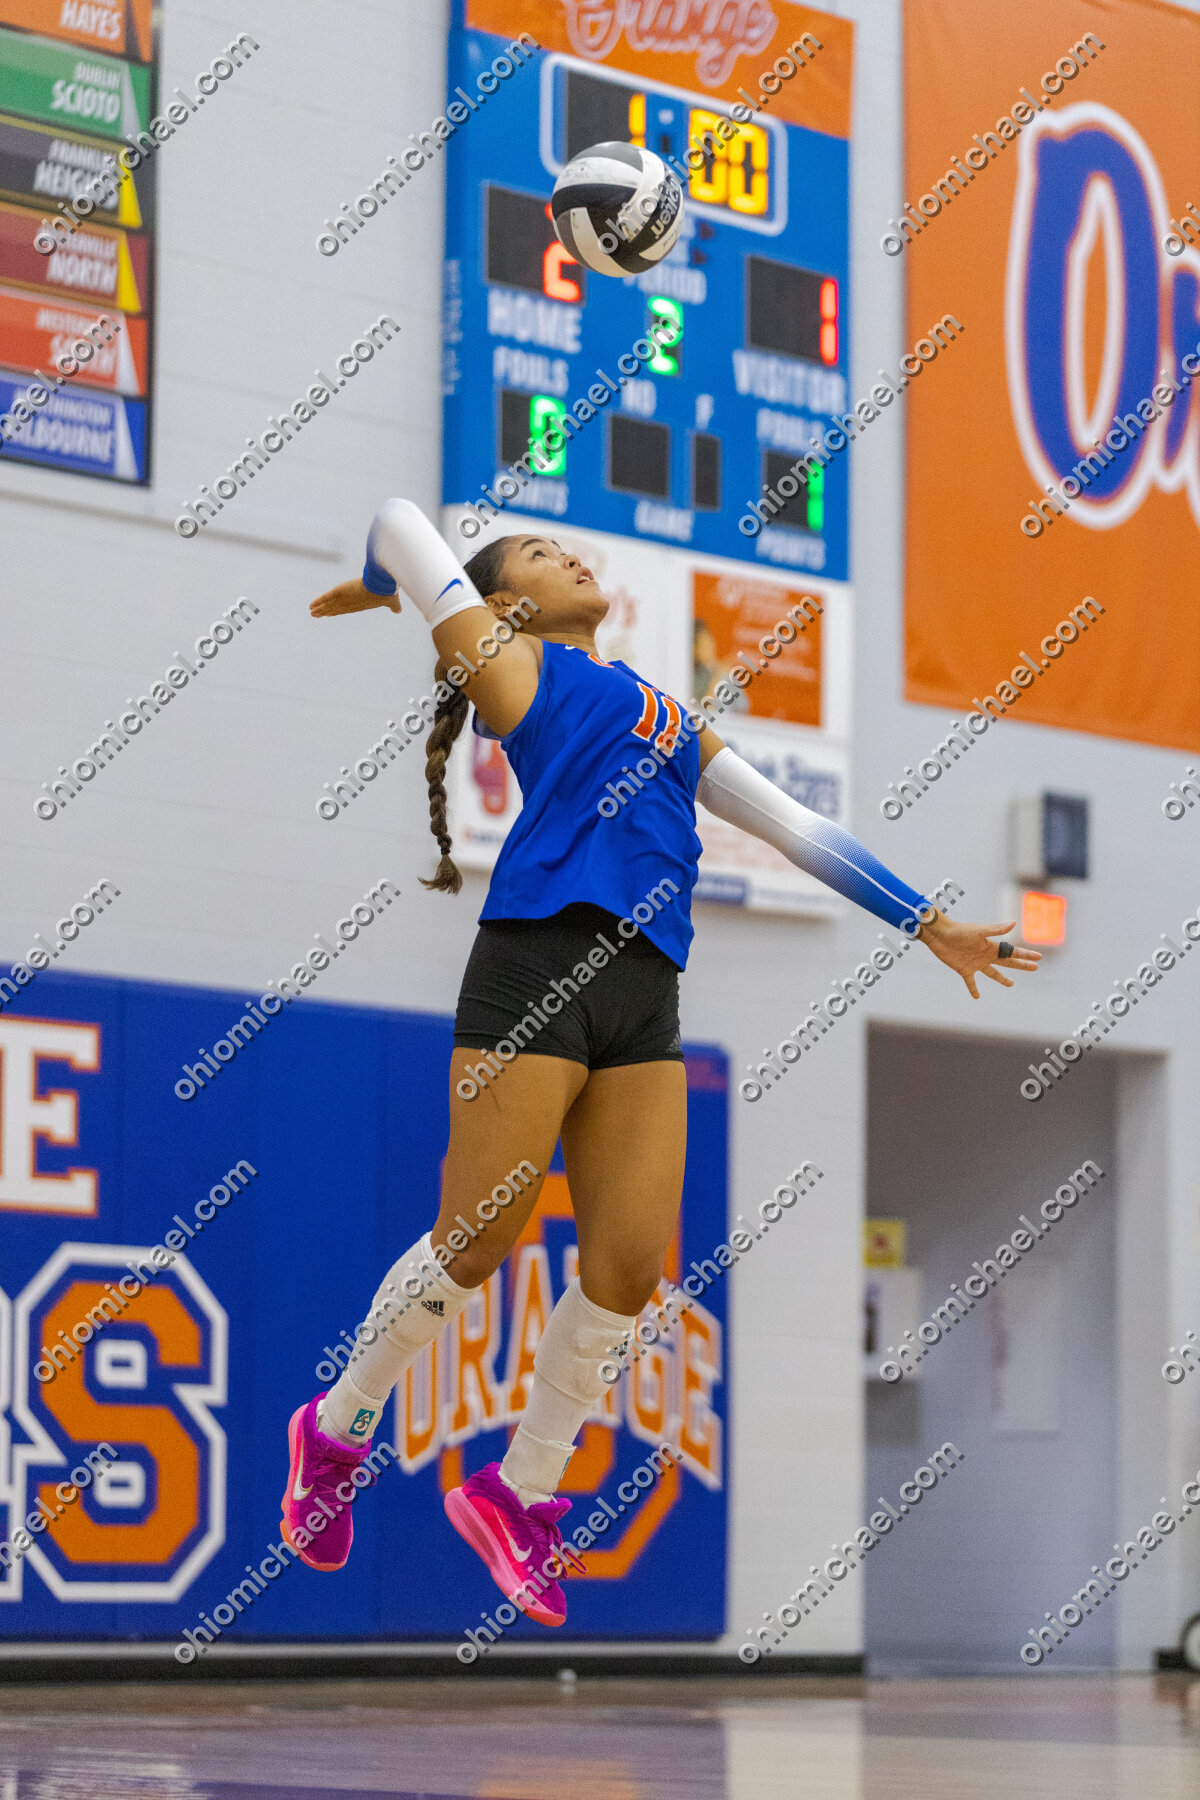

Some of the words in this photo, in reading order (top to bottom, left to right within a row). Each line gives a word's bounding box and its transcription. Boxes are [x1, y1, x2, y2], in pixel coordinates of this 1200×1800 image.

[59, 0, 122, 41] HAYES
[51, 79, 121, 123] SCIOTO
[46, 251, 118, 294] NORTH
[487, 284, 583, 355] HOME
[732, 349, 846, 416] VISITOR
[420, 1300, 446, 1318] adidas
[0, 1241, 229, 1603] S
